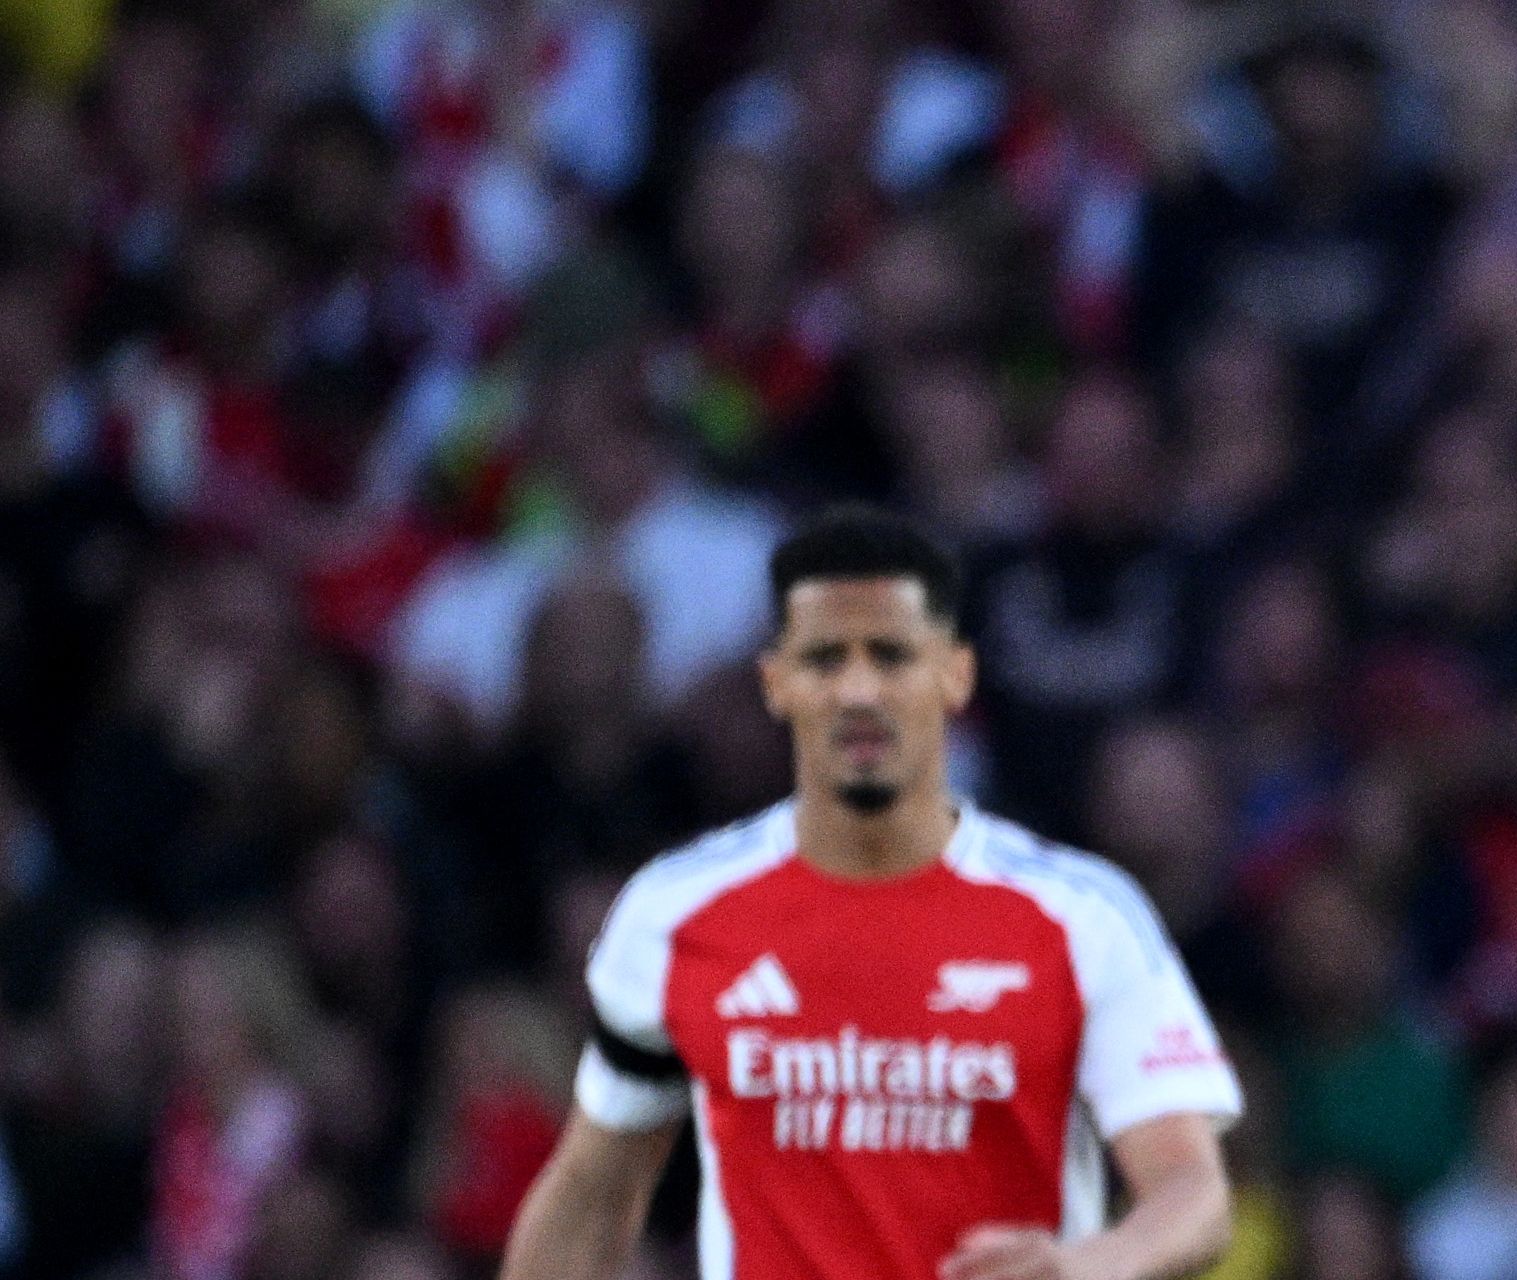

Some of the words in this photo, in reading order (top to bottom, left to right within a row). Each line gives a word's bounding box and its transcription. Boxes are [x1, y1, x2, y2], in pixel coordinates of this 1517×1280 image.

[726, 1024, 1017, 1102] Emirates
[774, 1098, 836, 1151] FLY
[840, 1098, 973, 1152] BETTER
